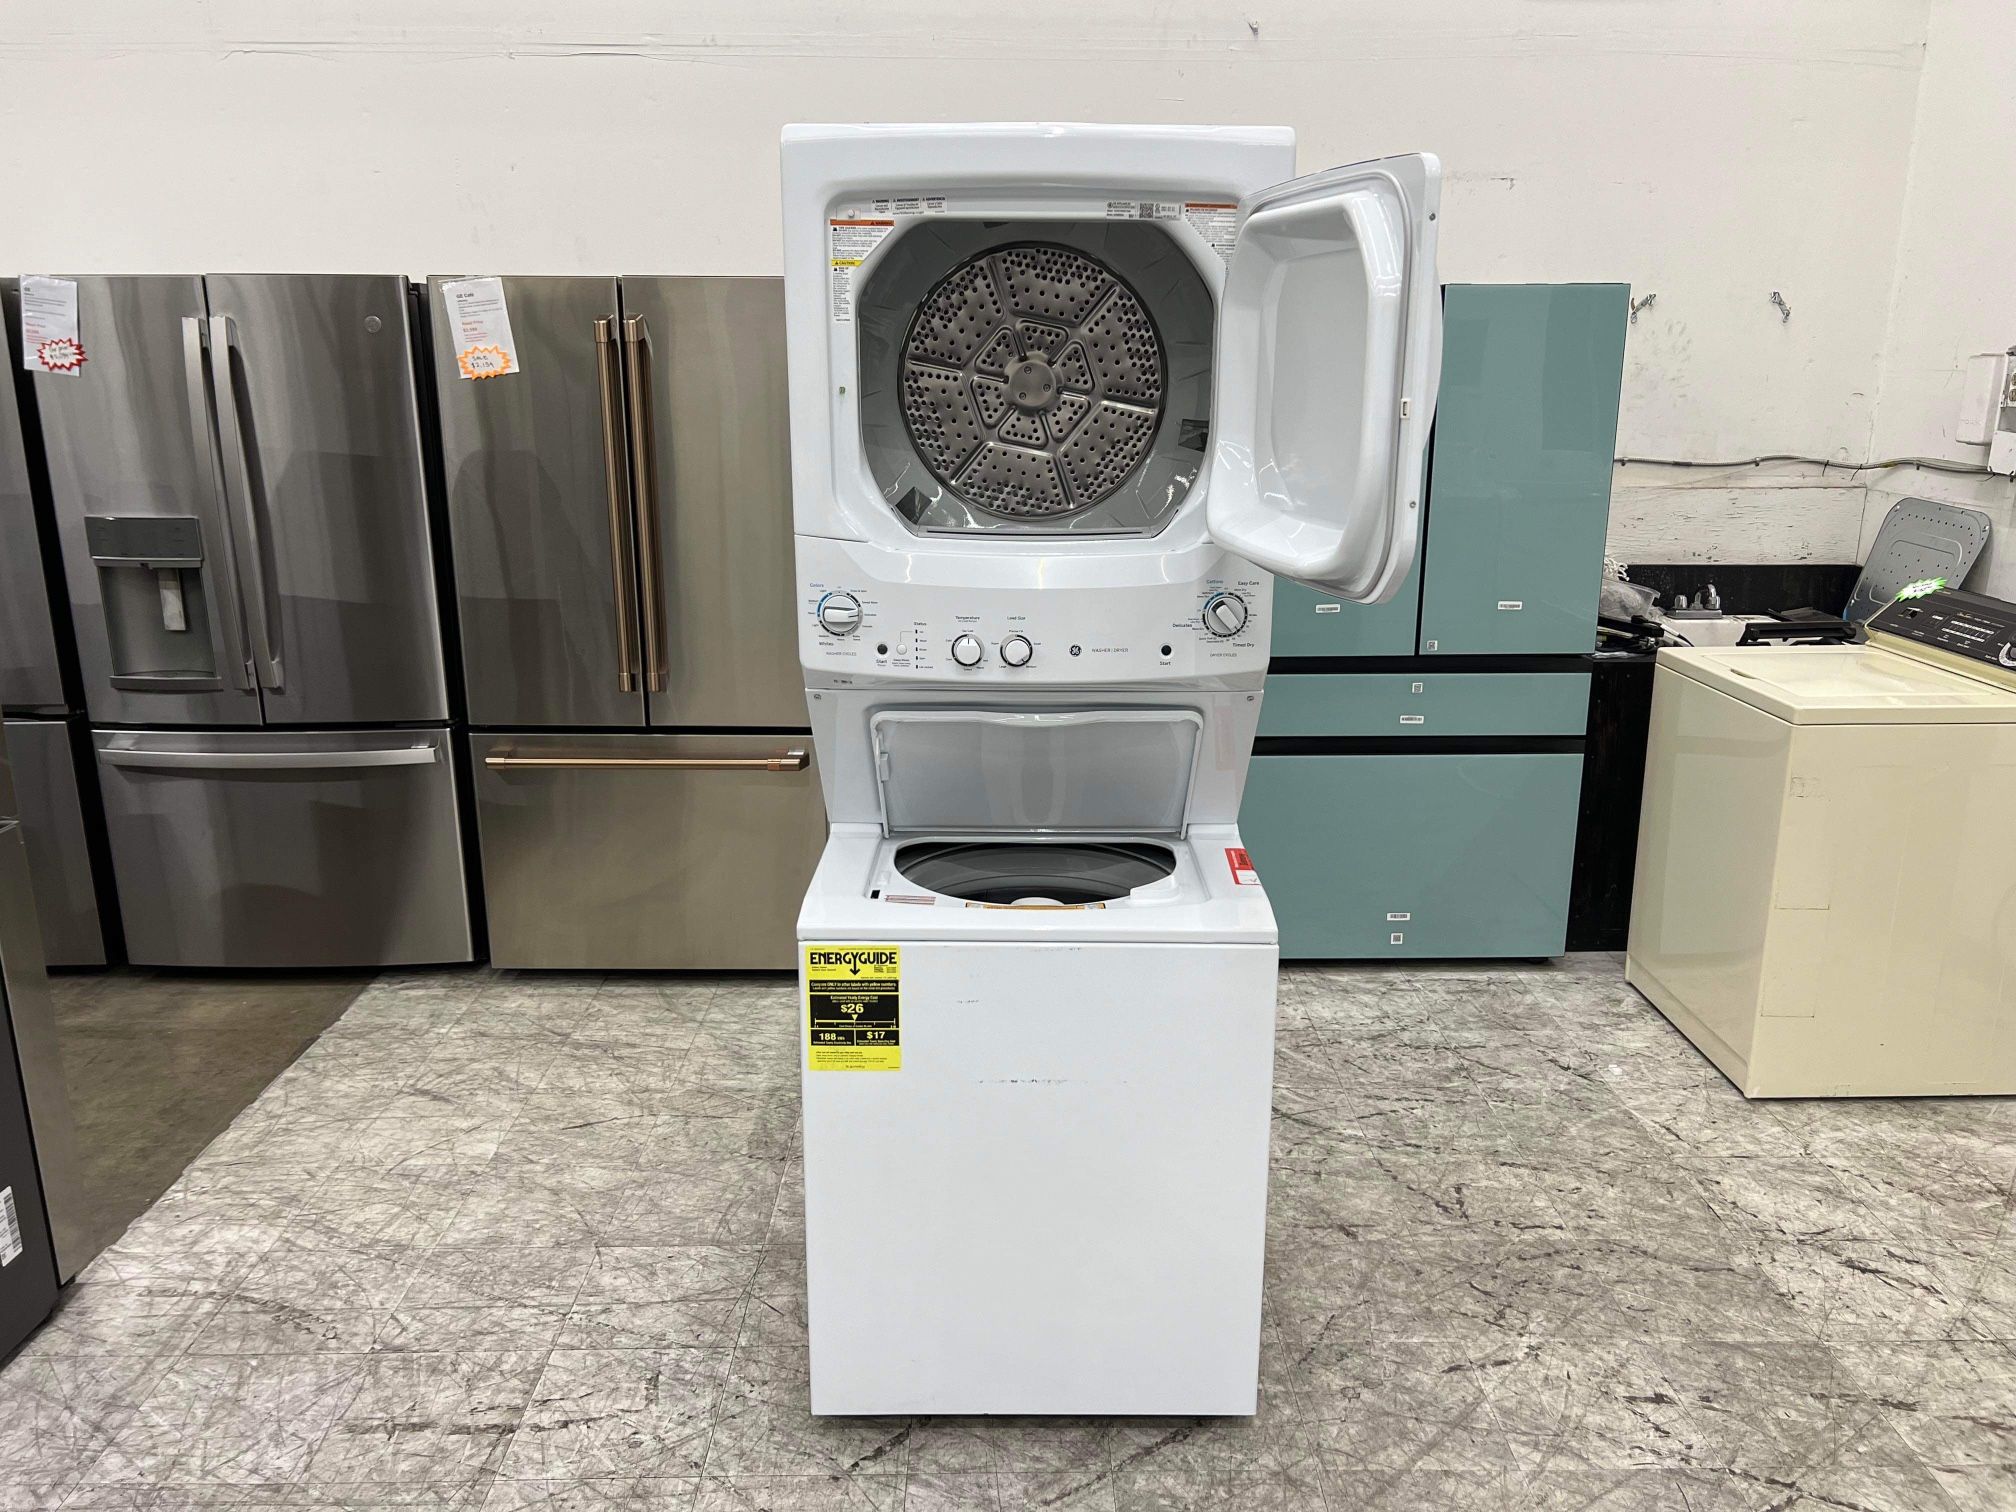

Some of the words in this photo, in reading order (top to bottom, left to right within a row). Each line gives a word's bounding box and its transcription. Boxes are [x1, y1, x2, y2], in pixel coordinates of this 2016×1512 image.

[810, 952, 897, 965] ENERGYGUIDE
[841, 1004, 864, 1013] $26
[867, 1031, 885, 1039] $17
